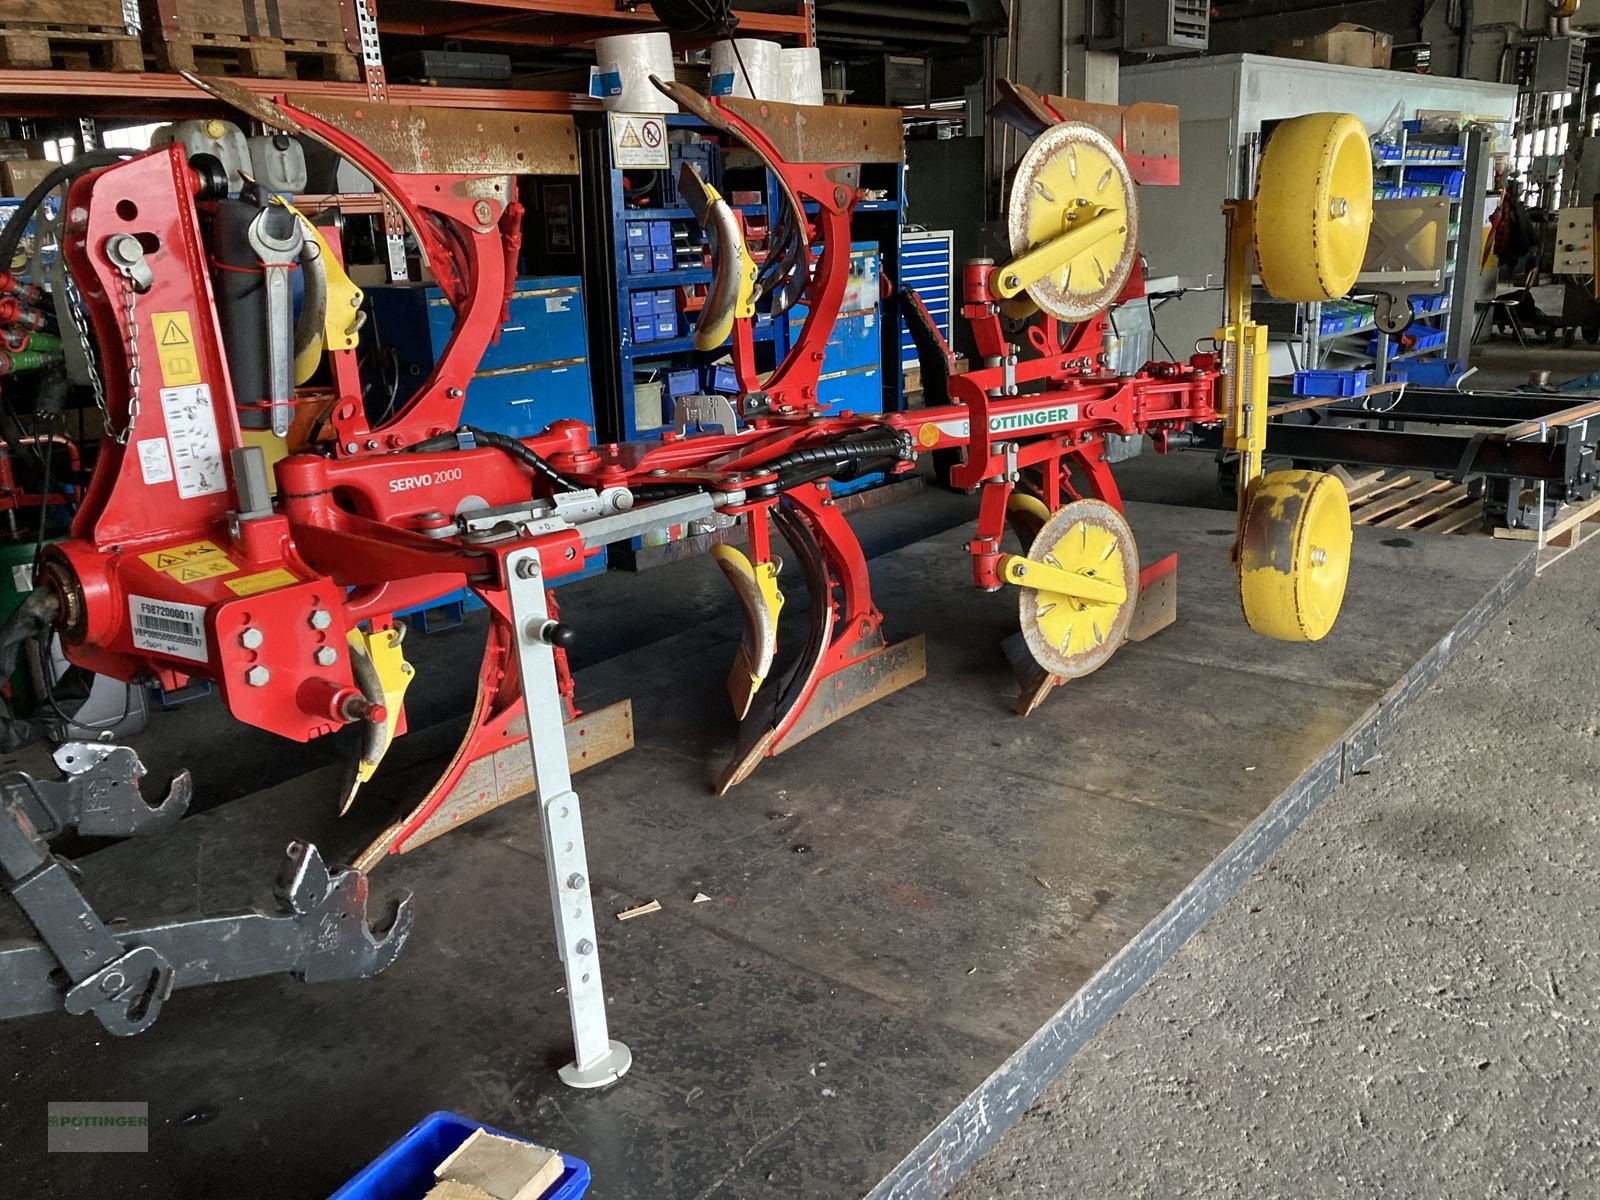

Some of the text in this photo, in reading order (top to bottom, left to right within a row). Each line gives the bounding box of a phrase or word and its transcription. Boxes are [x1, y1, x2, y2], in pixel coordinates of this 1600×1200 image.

[990, 409, 1068, 431] ÖTTINGER
[389, 468, 462, 493] SERVO 2000
[141, 603, 194, 621] F9872000011
